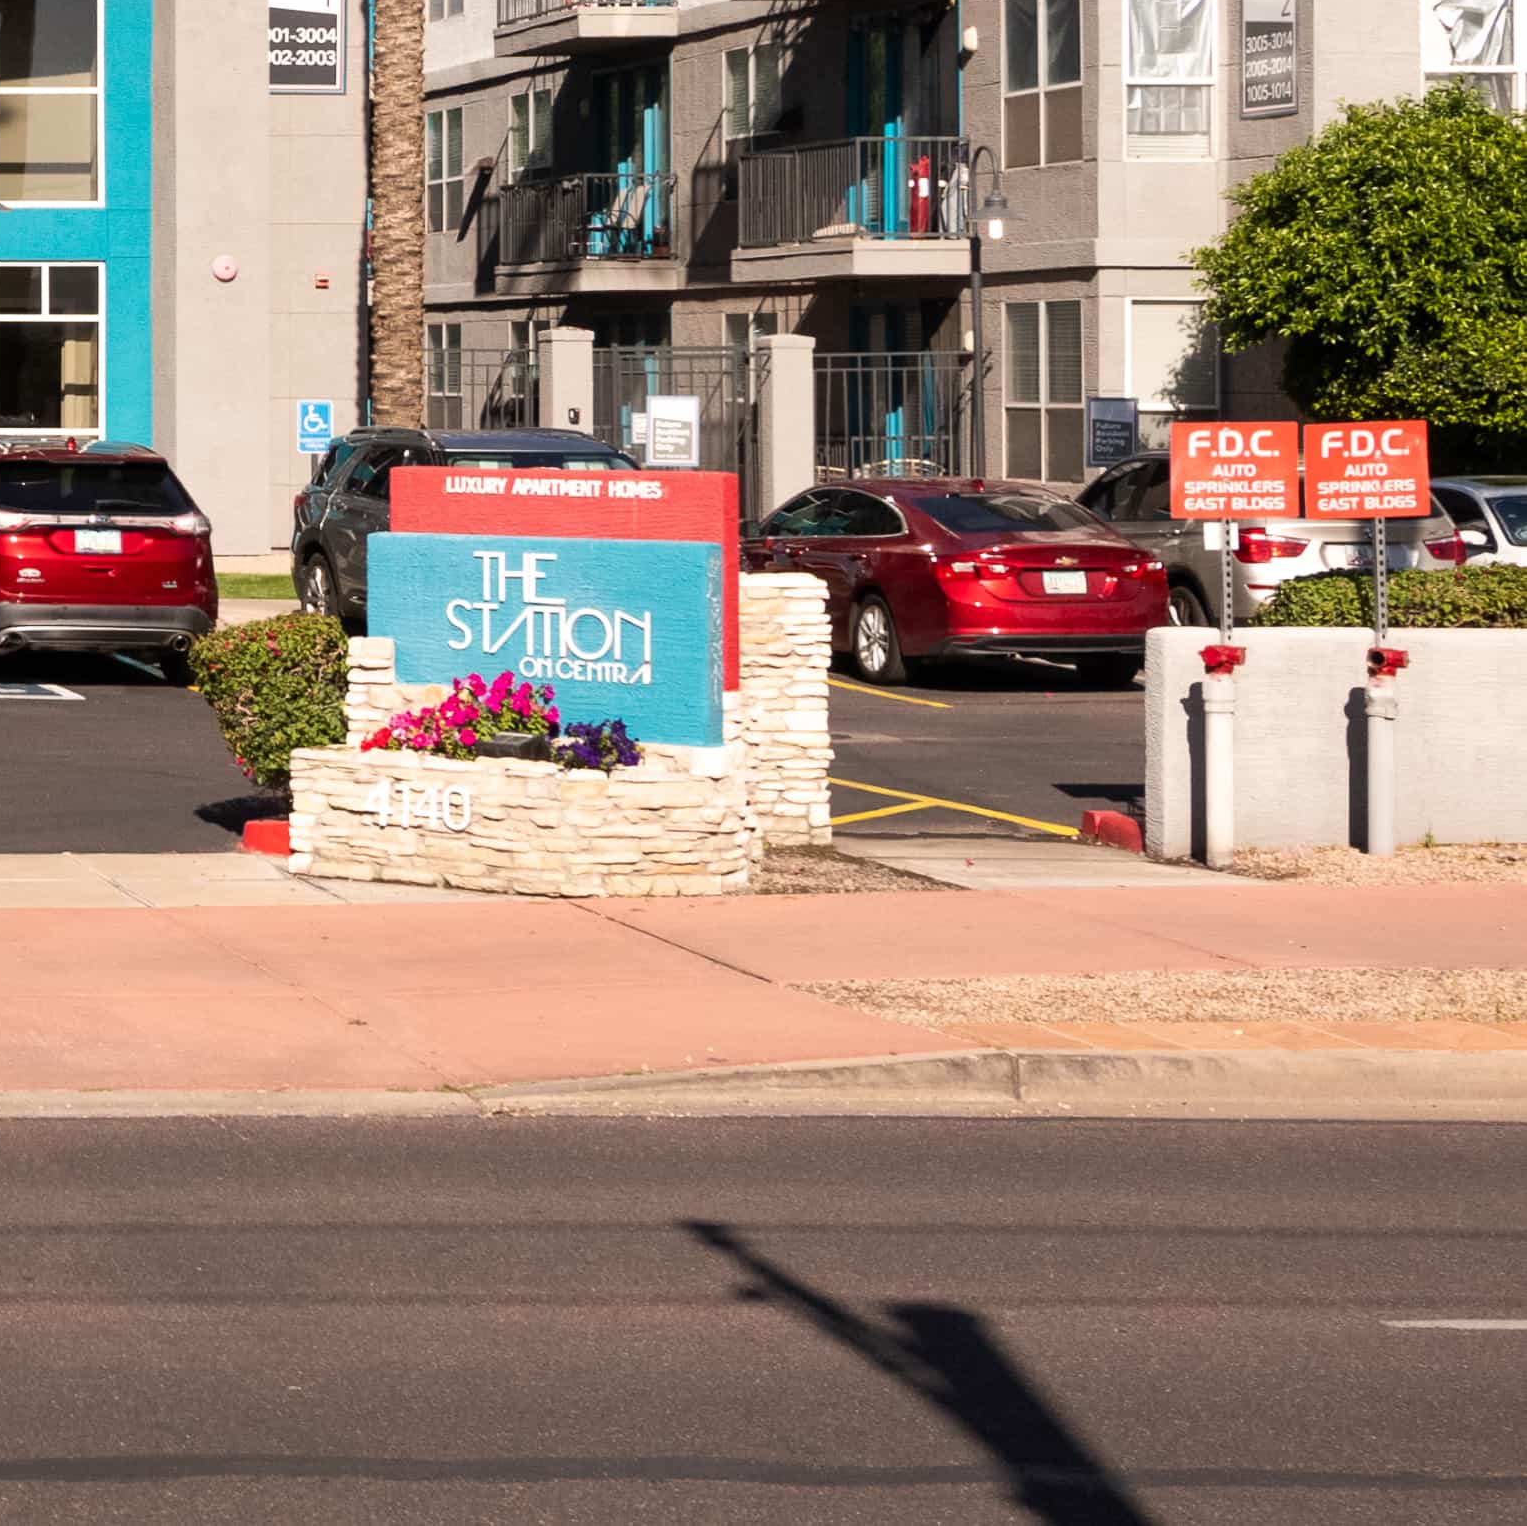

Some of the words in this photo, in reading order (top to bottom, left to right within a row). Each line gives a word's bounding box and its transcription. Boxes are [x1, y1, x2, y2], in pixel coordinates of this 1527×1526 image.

[268, 27, 337, 43] 01-3004
[1245, 31, 1292, 54] 3005-3014
[268, 50, 336, 66] 02-2003
[1245, 56, 1292, 78] 2005-2014
[1247, 81, 1292, 102] 1005-1014
[1188, 429, 1280, 458] F.D.C.
[1321, 428, 1410, 458] F.D.C.
[1212, 463, 1256, 477] AUTO
[1345, 463, 1388, 477] AUTO
[446, 476, 508, 495] LUXURY
[512, 477, 603, 498] APARTMENT
[608, 479, 664, 499] HOMES
[1184, 480, 1285, 494] SPRINKLERS
[1317, 478, 1416, 494] SPRINKLERS
[1184, 496, 1226, 510] EAST
[1231, 496, 1285, 510] BLDGS
[1318, 496, 1360, 511] EAST
[1364, 495, 1417, 510] BLDGS
[472, 551, 566, 605] THE
[446, 599, 651, 662] STATION
[519, 657, 554, 679] ON
[365, 780, 472, 831] 4140
